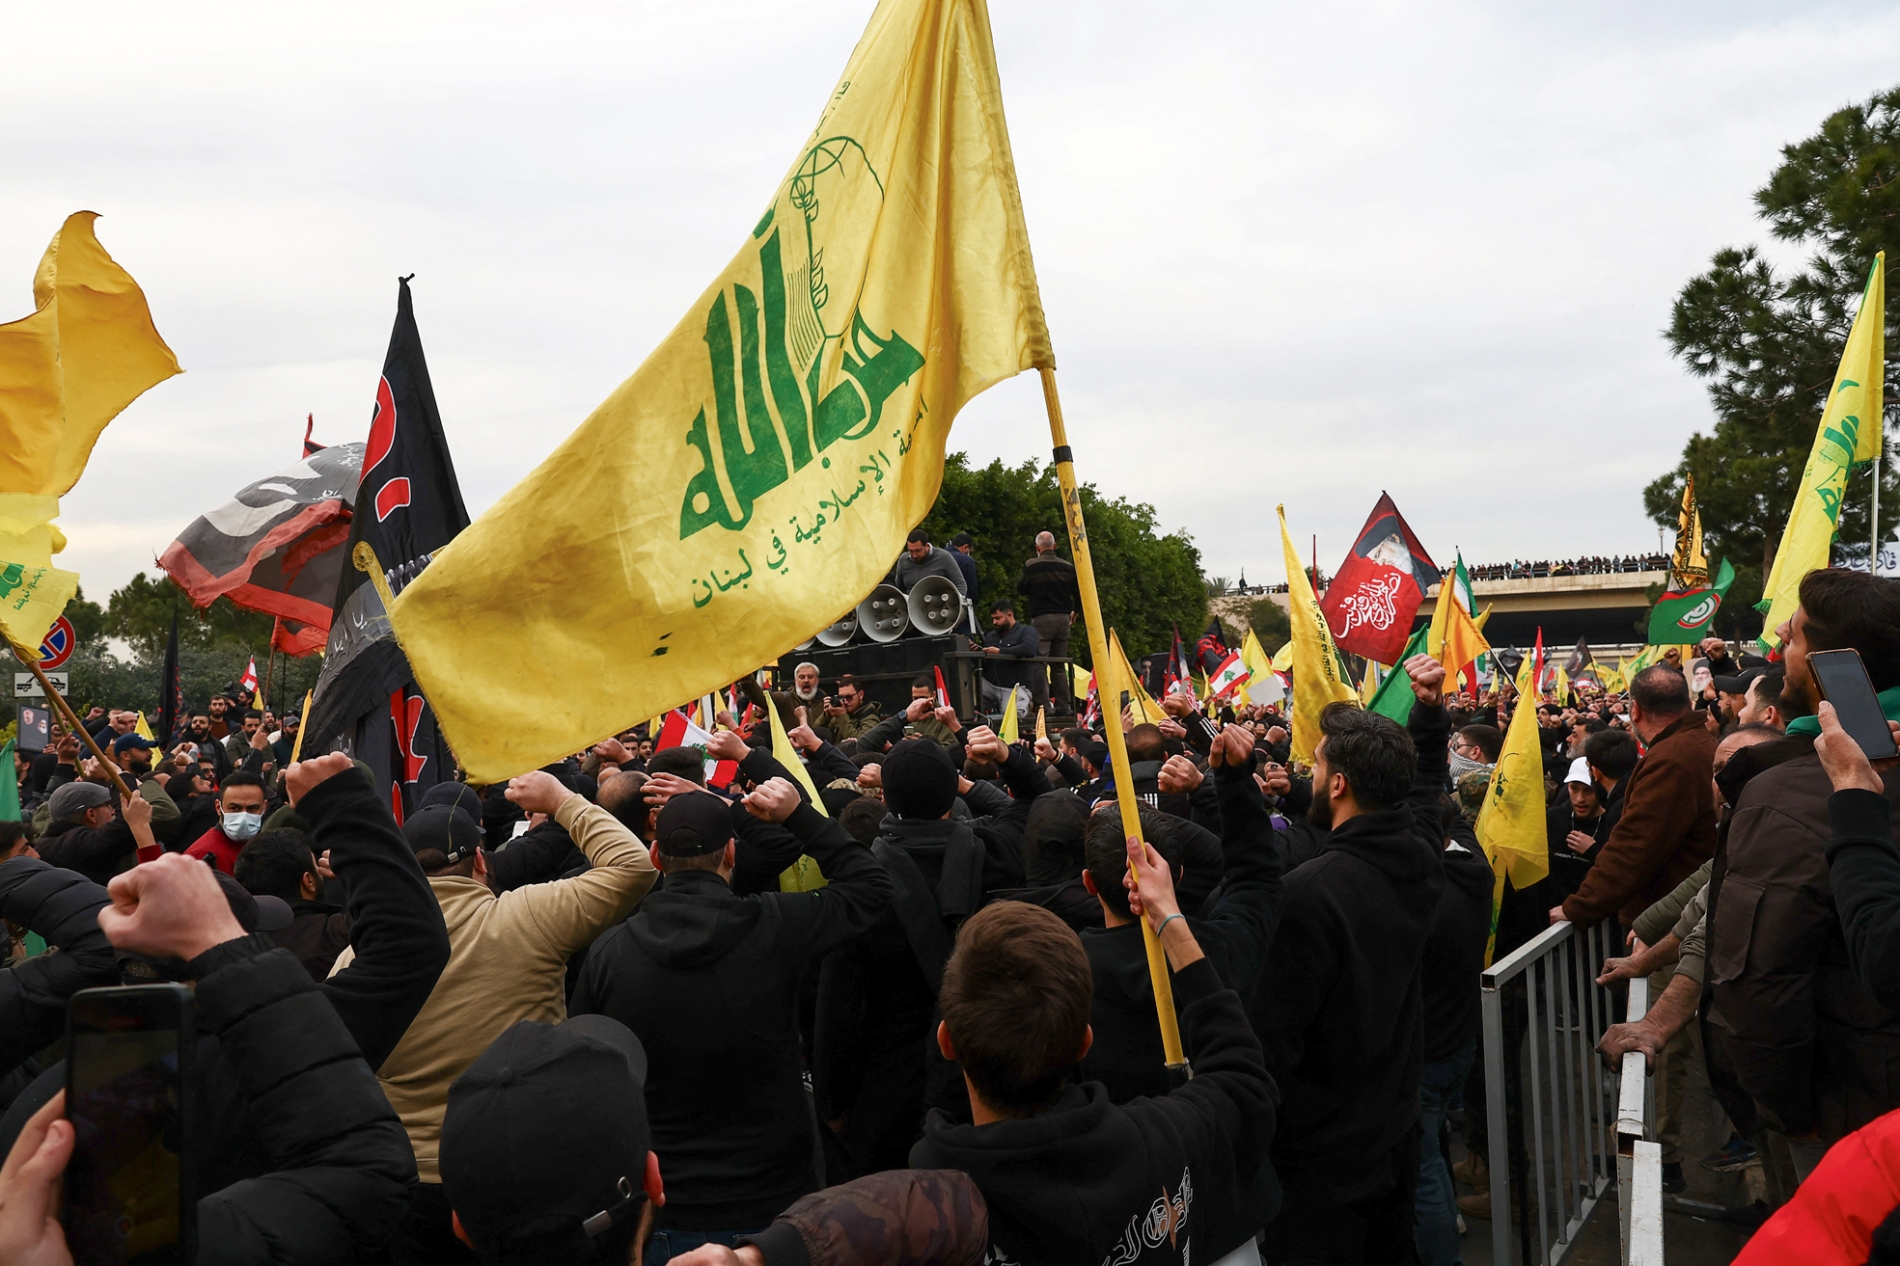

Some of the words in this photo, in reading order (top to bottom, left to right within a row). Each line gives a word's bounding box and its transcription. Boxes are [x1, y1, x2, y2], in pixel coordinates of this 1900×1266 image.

[789, 449, 891, 544] الإسلامية
[767, 529, 789, 575] في
[692, 548, 753, 608] لبنان
[1314, 612, 1326, 629] حزب
[1318, 630, 1326, 642] الله
[1321, 643, 1331, 654] هم
